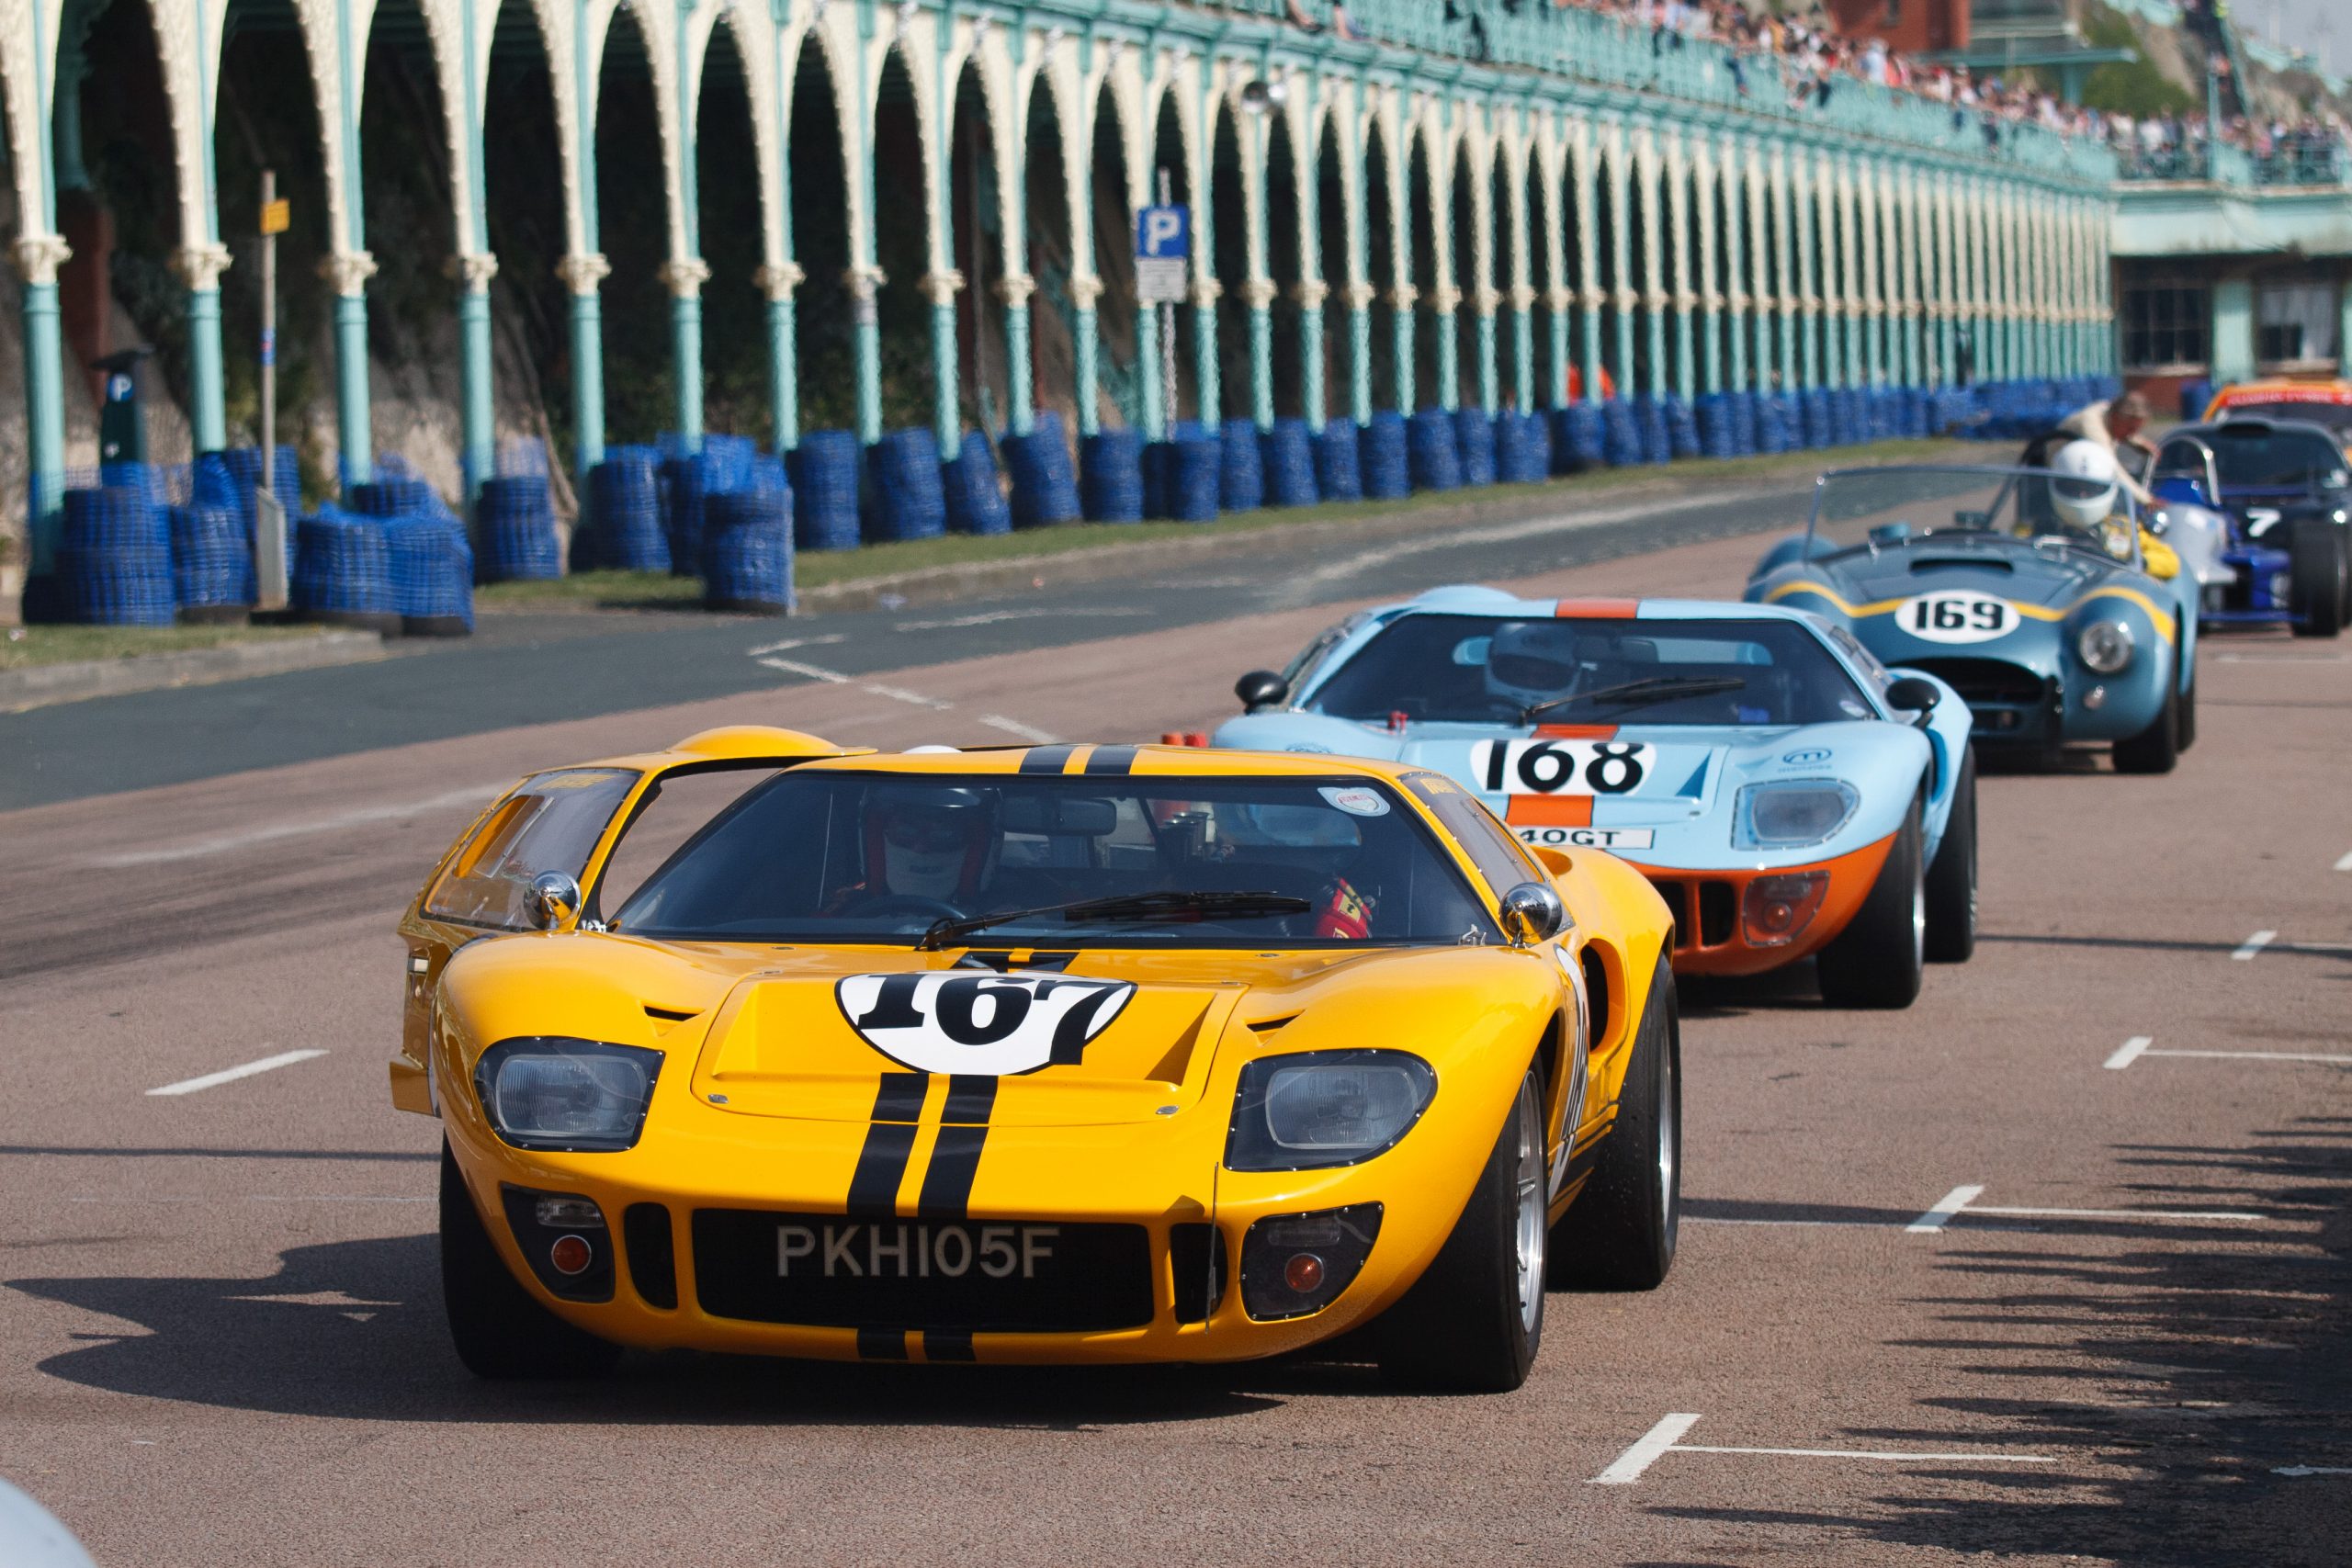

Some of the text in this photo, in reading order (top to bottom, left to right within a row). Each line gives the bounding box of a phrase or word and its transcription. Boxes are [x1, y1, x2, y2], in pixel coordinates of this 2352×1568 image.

[1146, 210, 1182, 256] P
[113, 374, 133, 402] P
[2245, 507, 2282, 537] 7
[1916, 600, 2004, 630] 169
[1486, 739, 1645, 794] 168
[856, 973, 1136, 1066] 167
[776, 1224, 1060, 1279] PKH105F
